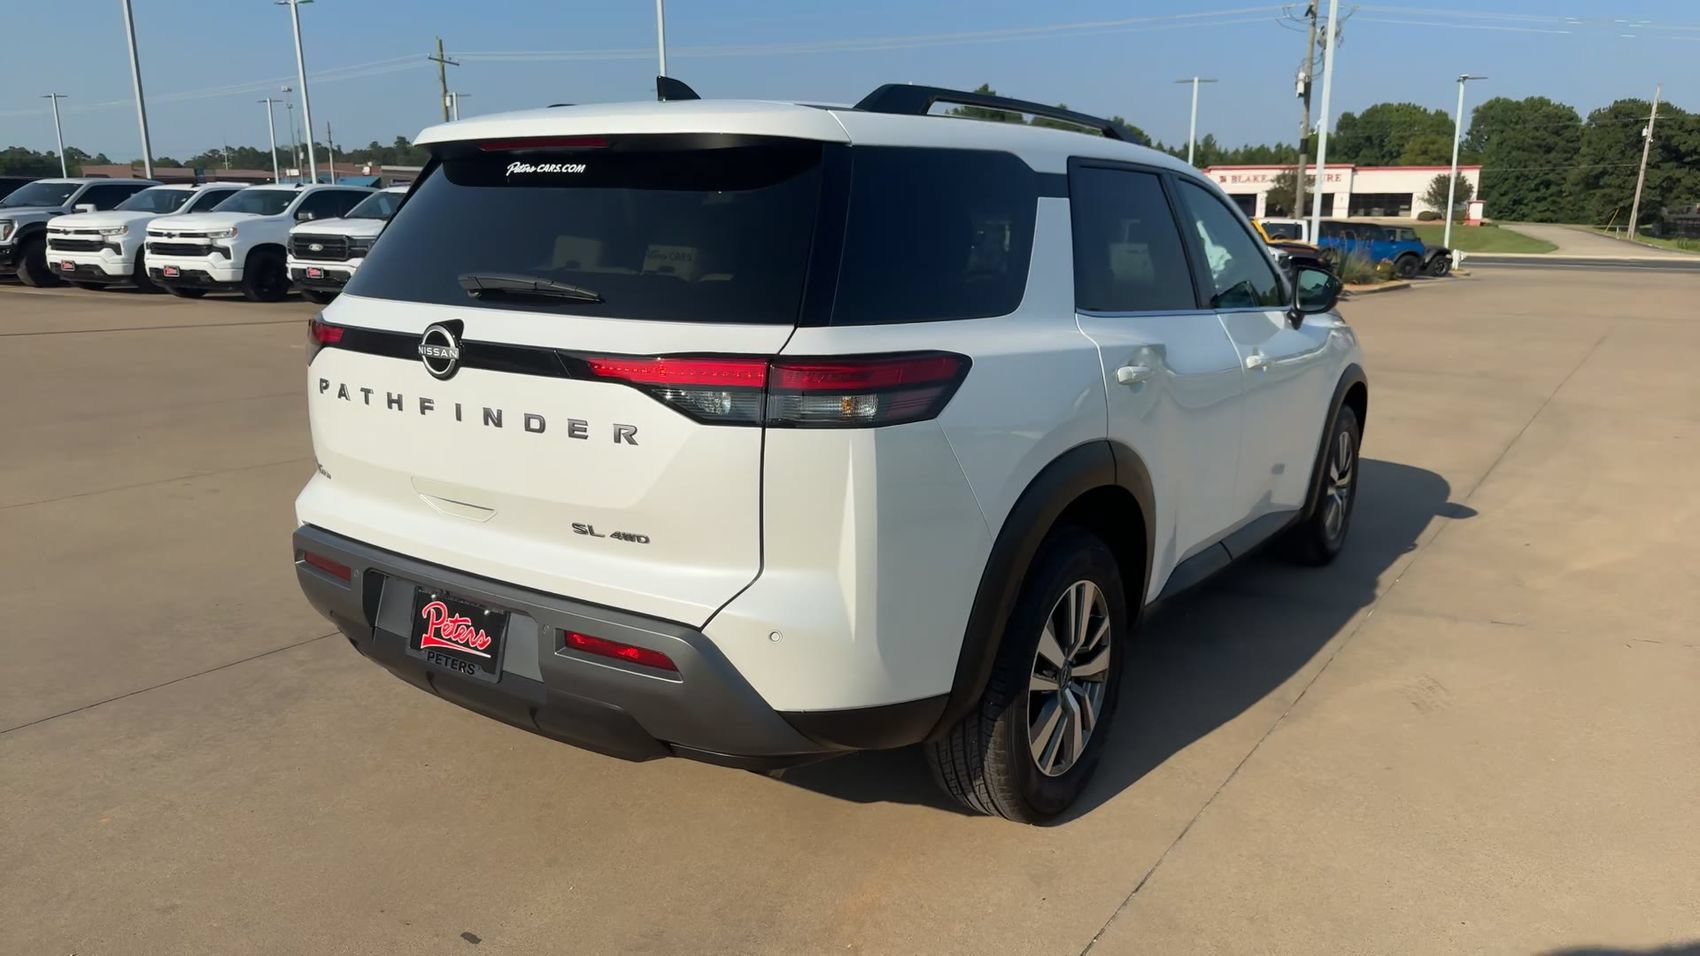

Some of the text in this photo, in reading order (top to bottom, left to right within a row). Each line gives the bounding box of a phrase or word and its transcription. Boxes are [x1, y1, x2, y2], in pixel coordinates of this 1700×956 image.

[1231, 174, 1268, 184] BLAKE
[418, 345, 459, 359] NISSAN
[319, 377, 639, 446] PATHFINDER
[571, 522, 650, 544] SL 4WD
[422, 601, 491, 650] Peters
[427, 650, 476, 676] PETERS
